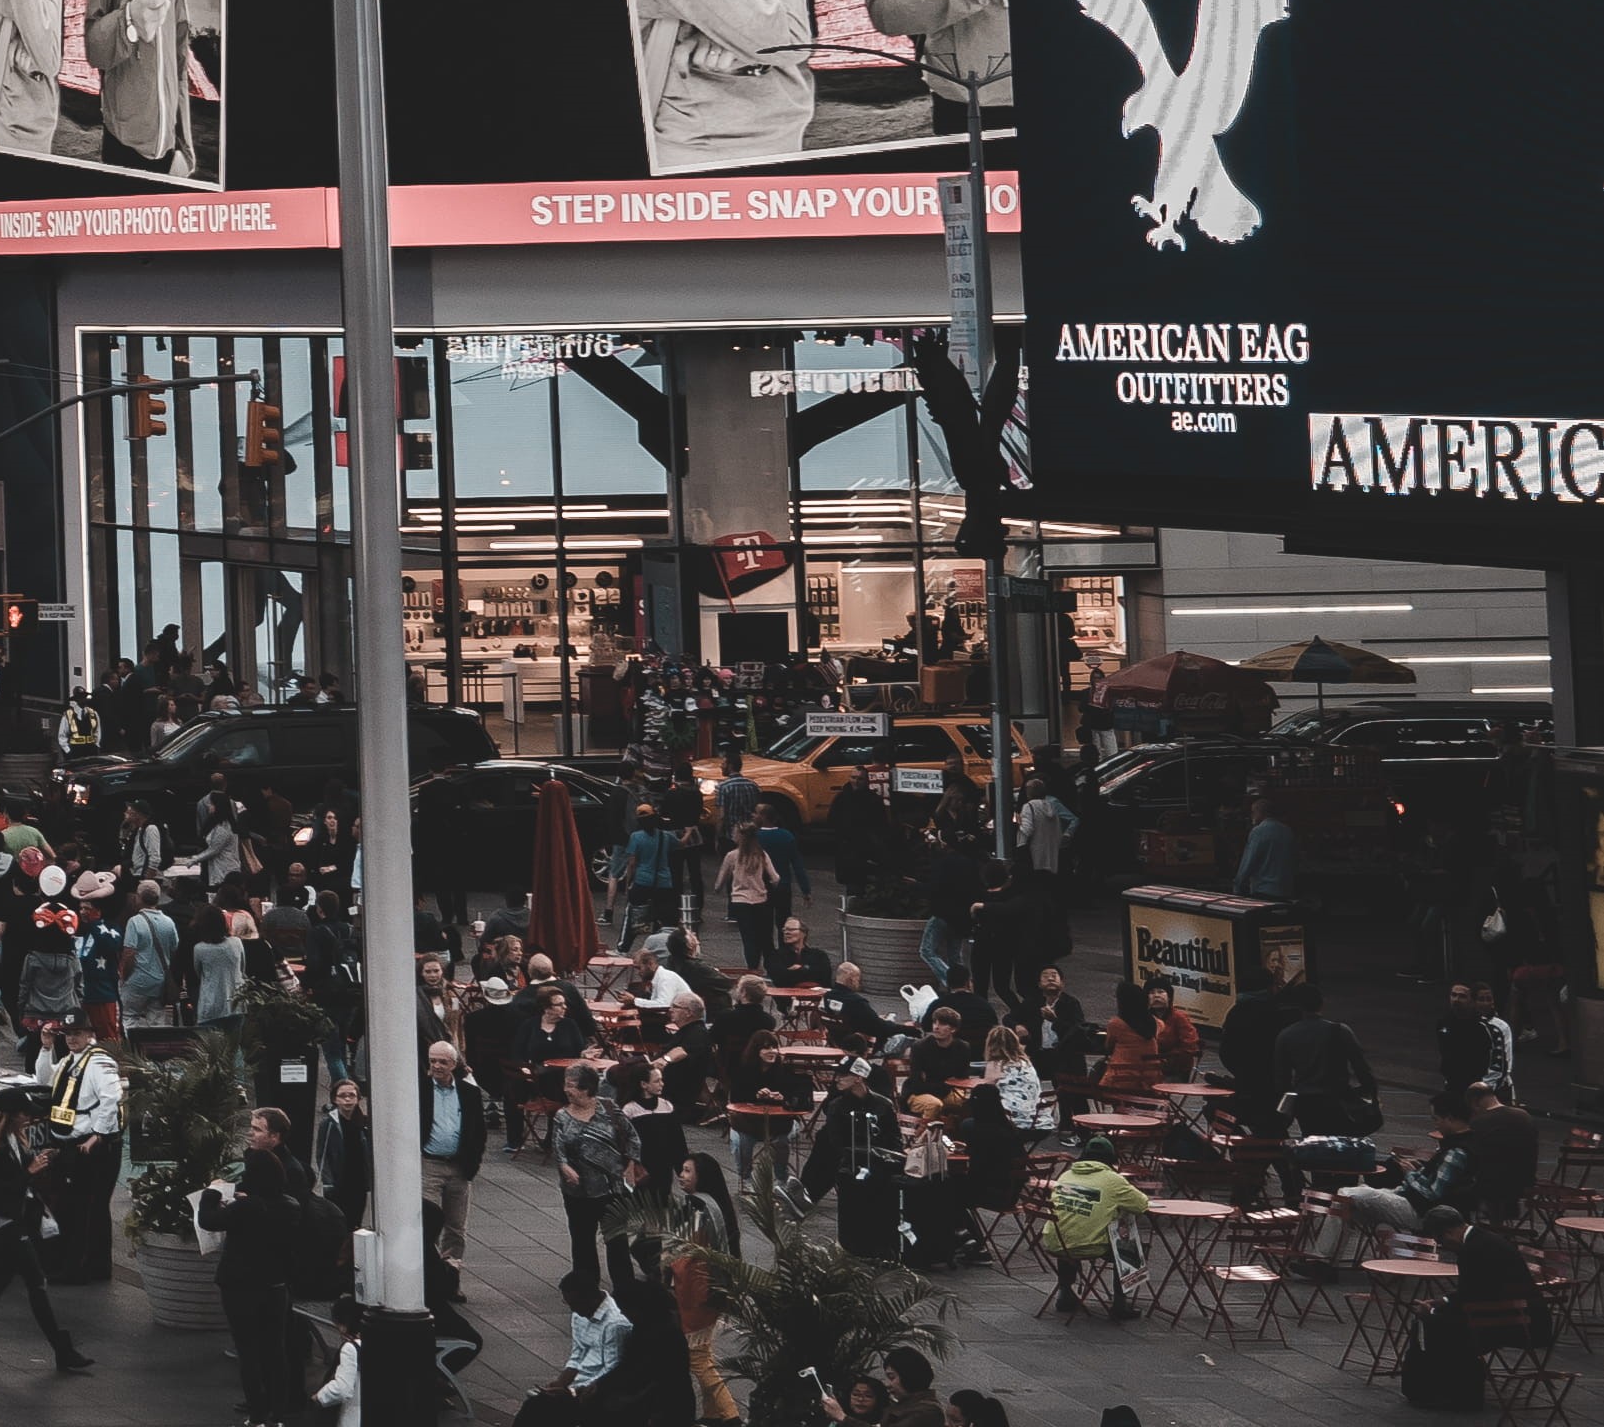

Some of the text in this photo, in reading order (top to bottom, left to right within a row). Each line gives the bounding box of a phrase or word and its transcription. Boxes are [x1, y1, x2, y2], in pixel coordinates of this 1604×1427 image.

[1, 202, 277, 239] INSIDE. SNAP YOUR PHOTO. GET HERE.
[530, 185, 939, 227] STEP INSIDE. SNAP YOUR
[1056, 323, 1310, 364] AMERICAN EAG
[1117, 371, 1291, 407] OUTFITTERS
[1170, 411, 1237, 434] ae.com
[1135, 925, 1229, 976] Beautiful
